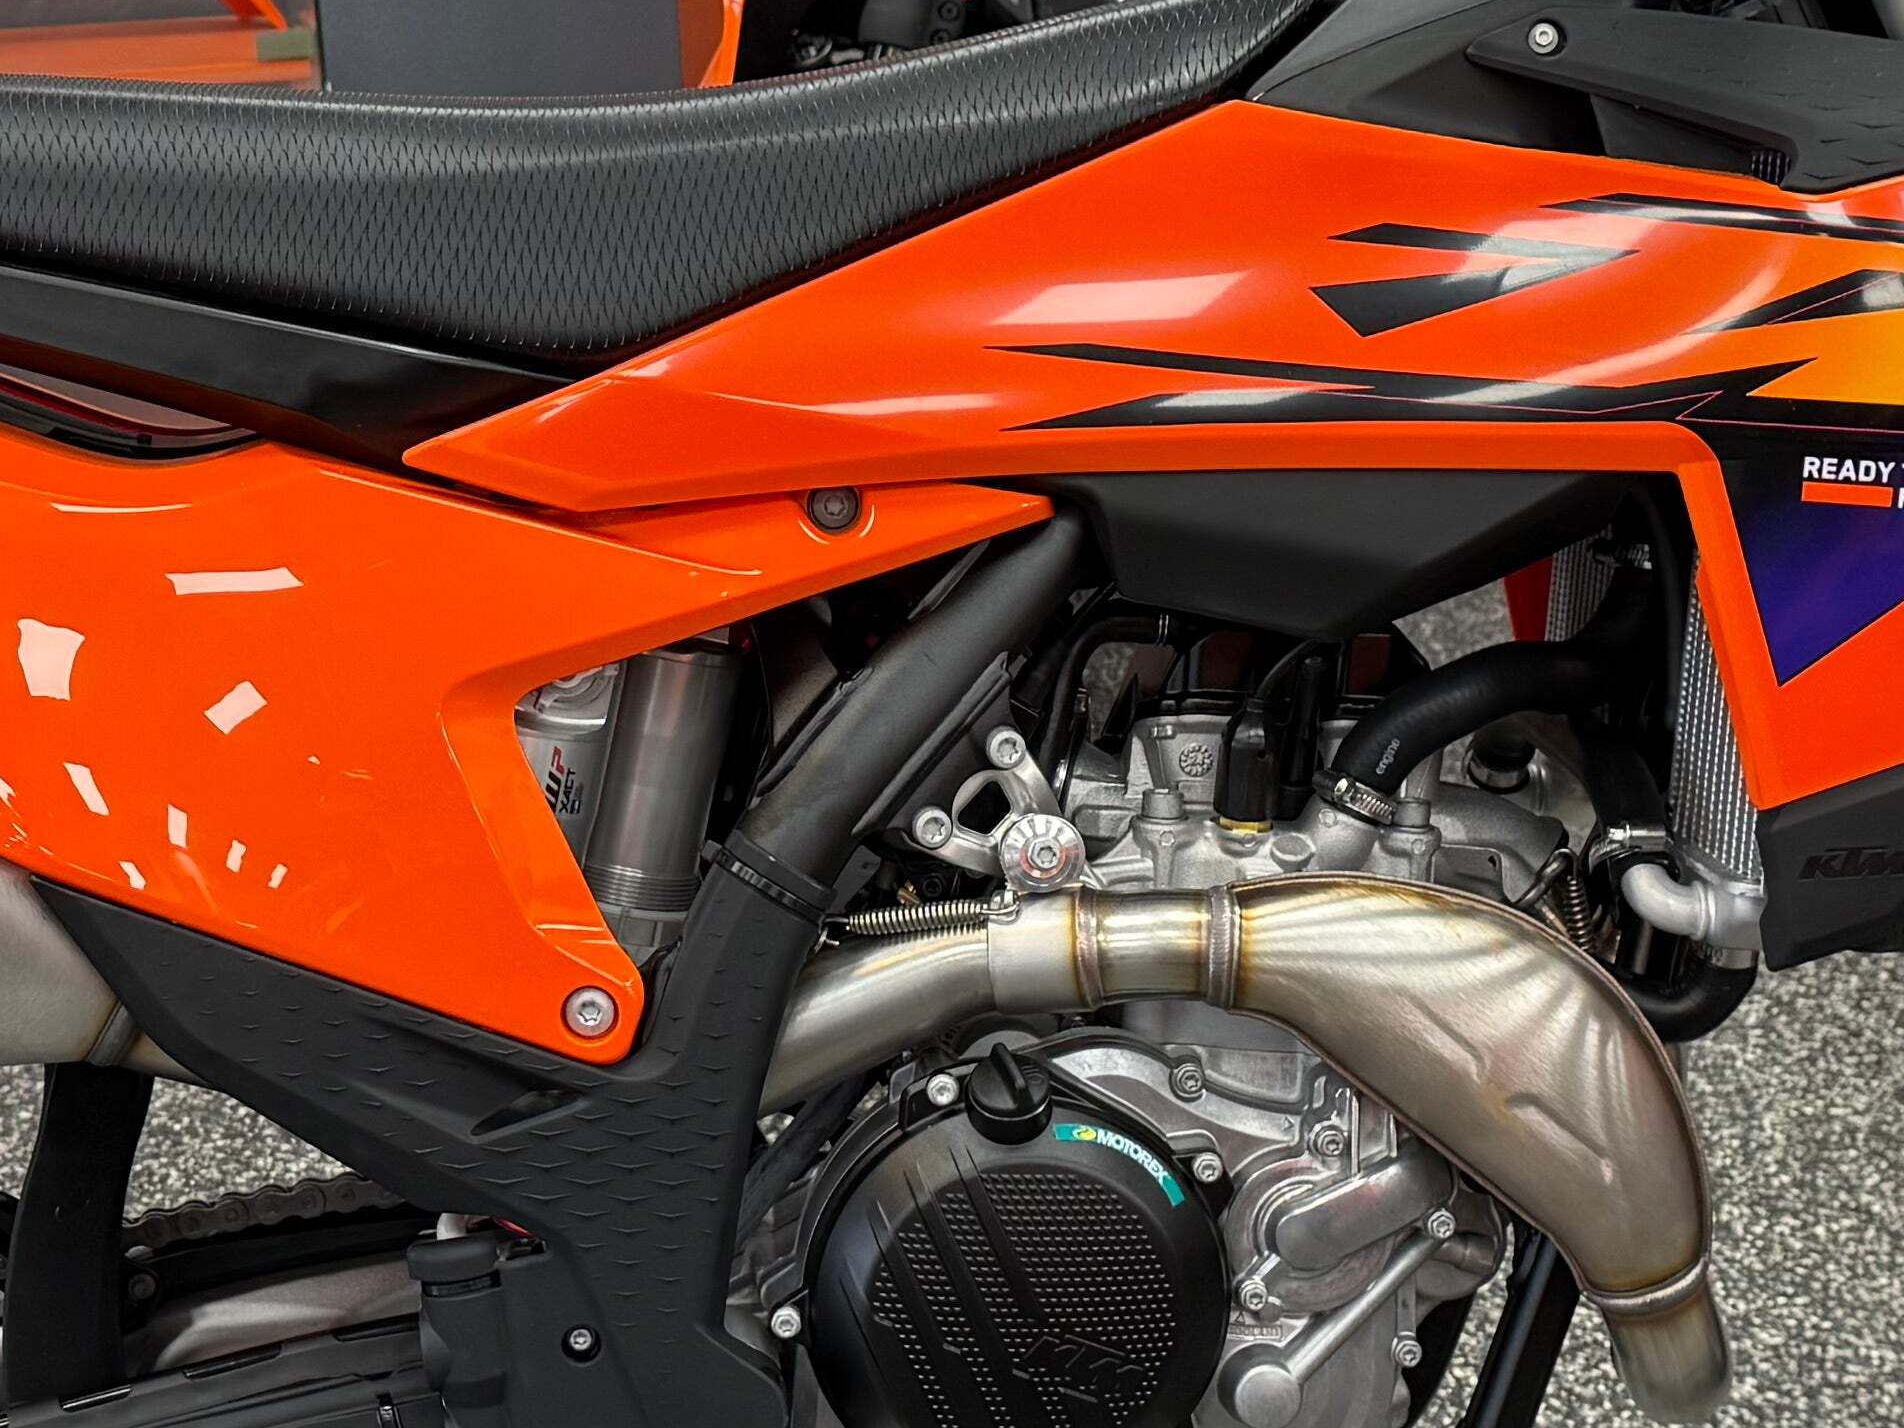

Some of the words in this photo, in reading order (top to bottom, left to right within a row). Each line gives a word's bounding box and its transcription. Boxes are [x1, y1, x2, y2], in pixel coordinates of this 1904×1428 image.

[1802, 456, 1896, 484] READY
[545, 745, 565, 814] WP
[559, 767, 576, 813] XACT
[1097, 1128, 1172, 1187] MOTOREX
